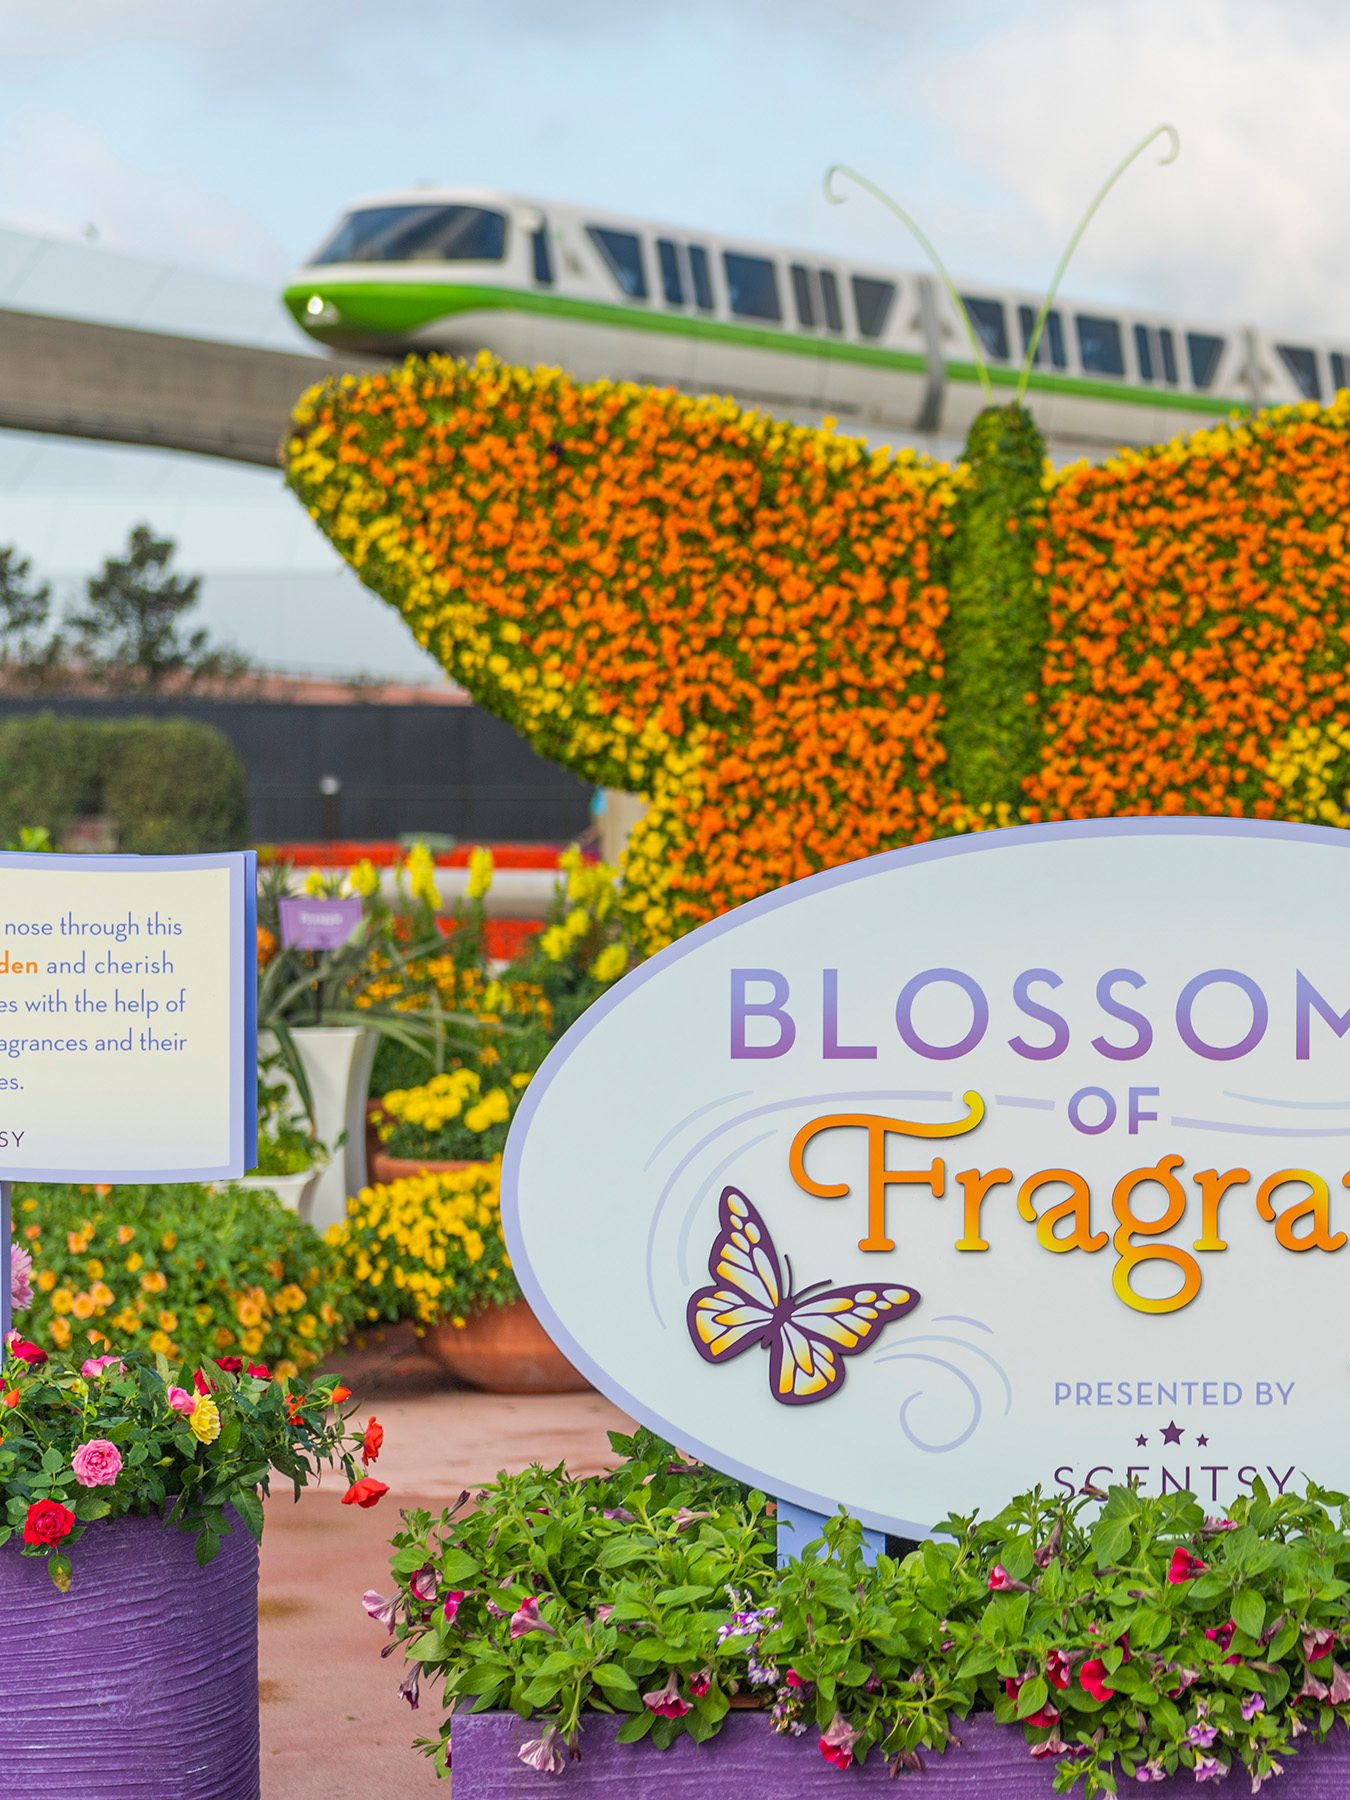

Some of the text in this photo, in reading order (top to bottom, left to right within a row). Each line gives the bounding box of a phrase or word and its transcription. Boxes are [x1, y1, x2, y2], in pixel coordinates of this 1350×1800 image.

[5, 911, 183, 943] nose through this
[46, 949, 87, 975] and
[94, 949, 174, 975] cherish
[24, 988, 68, 1013] with
[74, 988, 108, 1013] the
[114, 988, 161, 1019] help
[165, 987, 187, 1013] of
[94, 1026, 133, 1052] and
[139, 1026, 188, 1052] their
[1067, 1087, 1160, 1135] OF
[1055, 1382, 1295, 1406] PRESENTED BY
